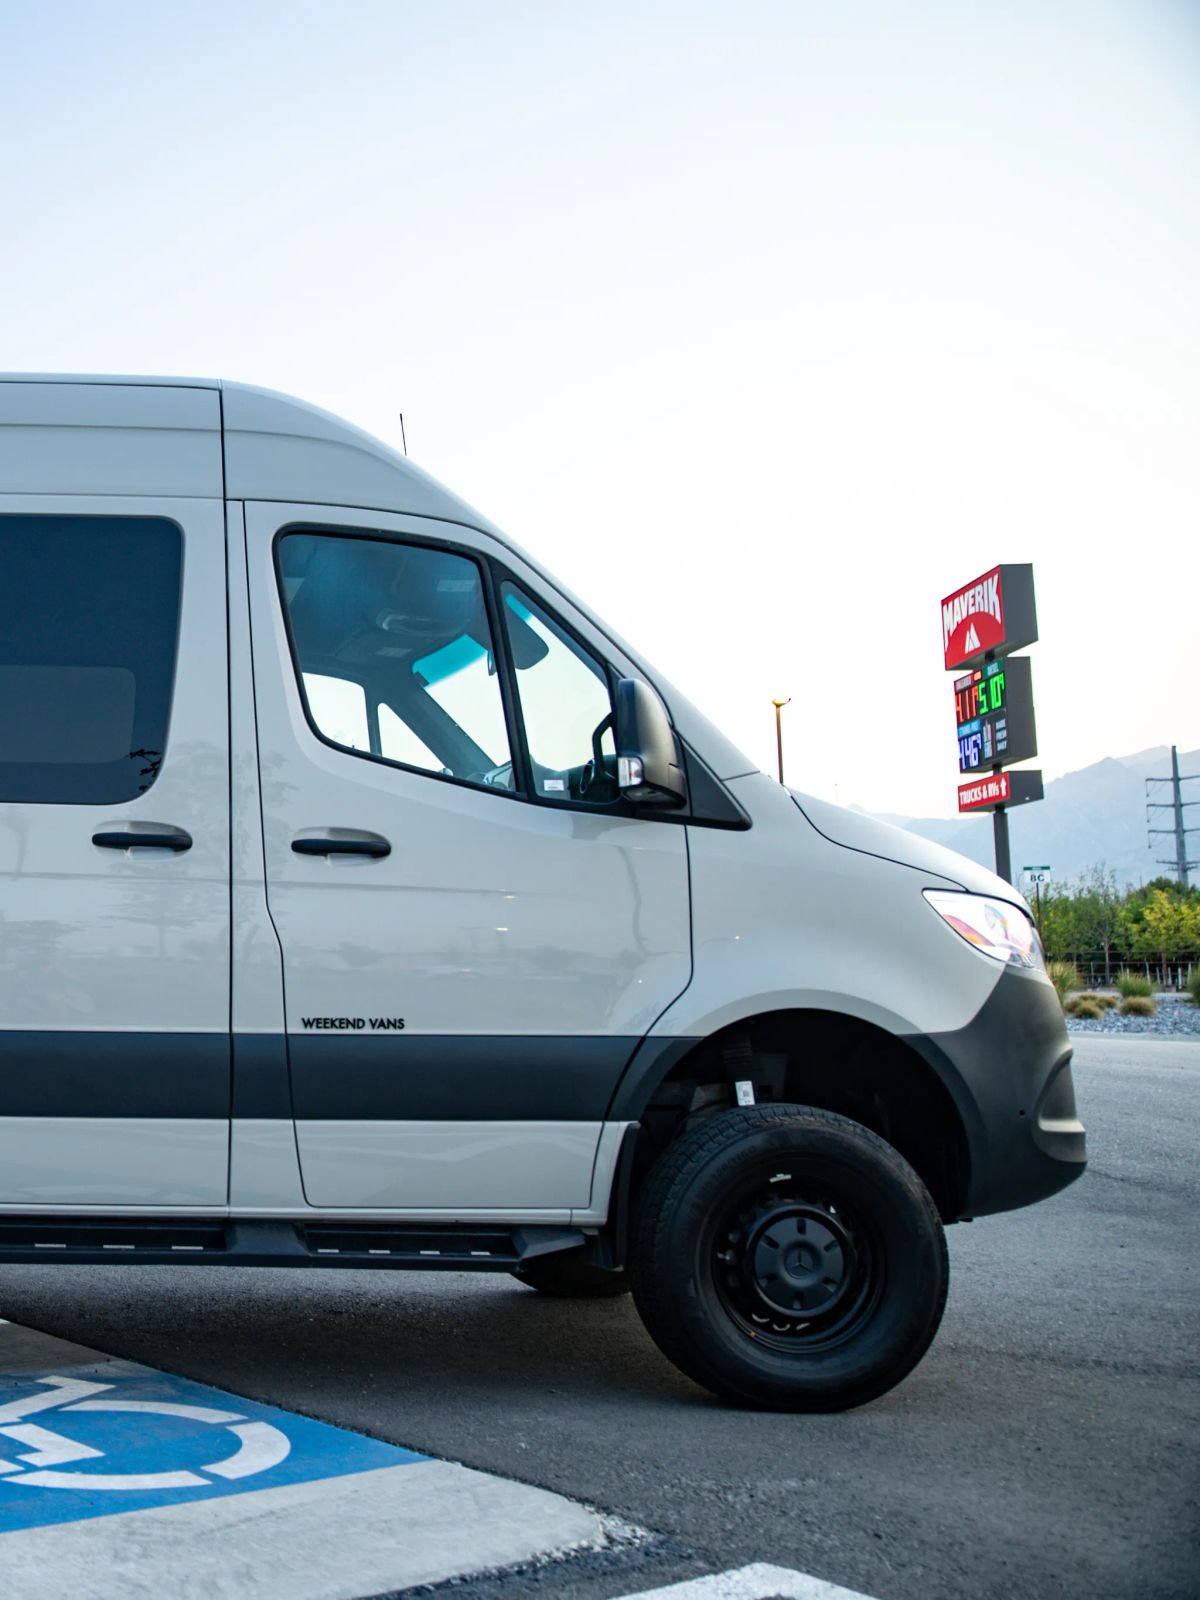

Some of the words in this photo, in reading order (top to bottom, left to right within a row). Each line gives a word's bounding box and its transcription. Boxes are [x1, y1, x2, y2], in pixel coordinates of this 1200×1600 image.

[943, 574, 1001, 652] MAVERIK
[960, 786, 981, 804] TRUCKS
[982, 783, 988, 799] &
[302, 1017, 366, 1030] WEEKEND
[369, 1018, 405, 1030] VANS
